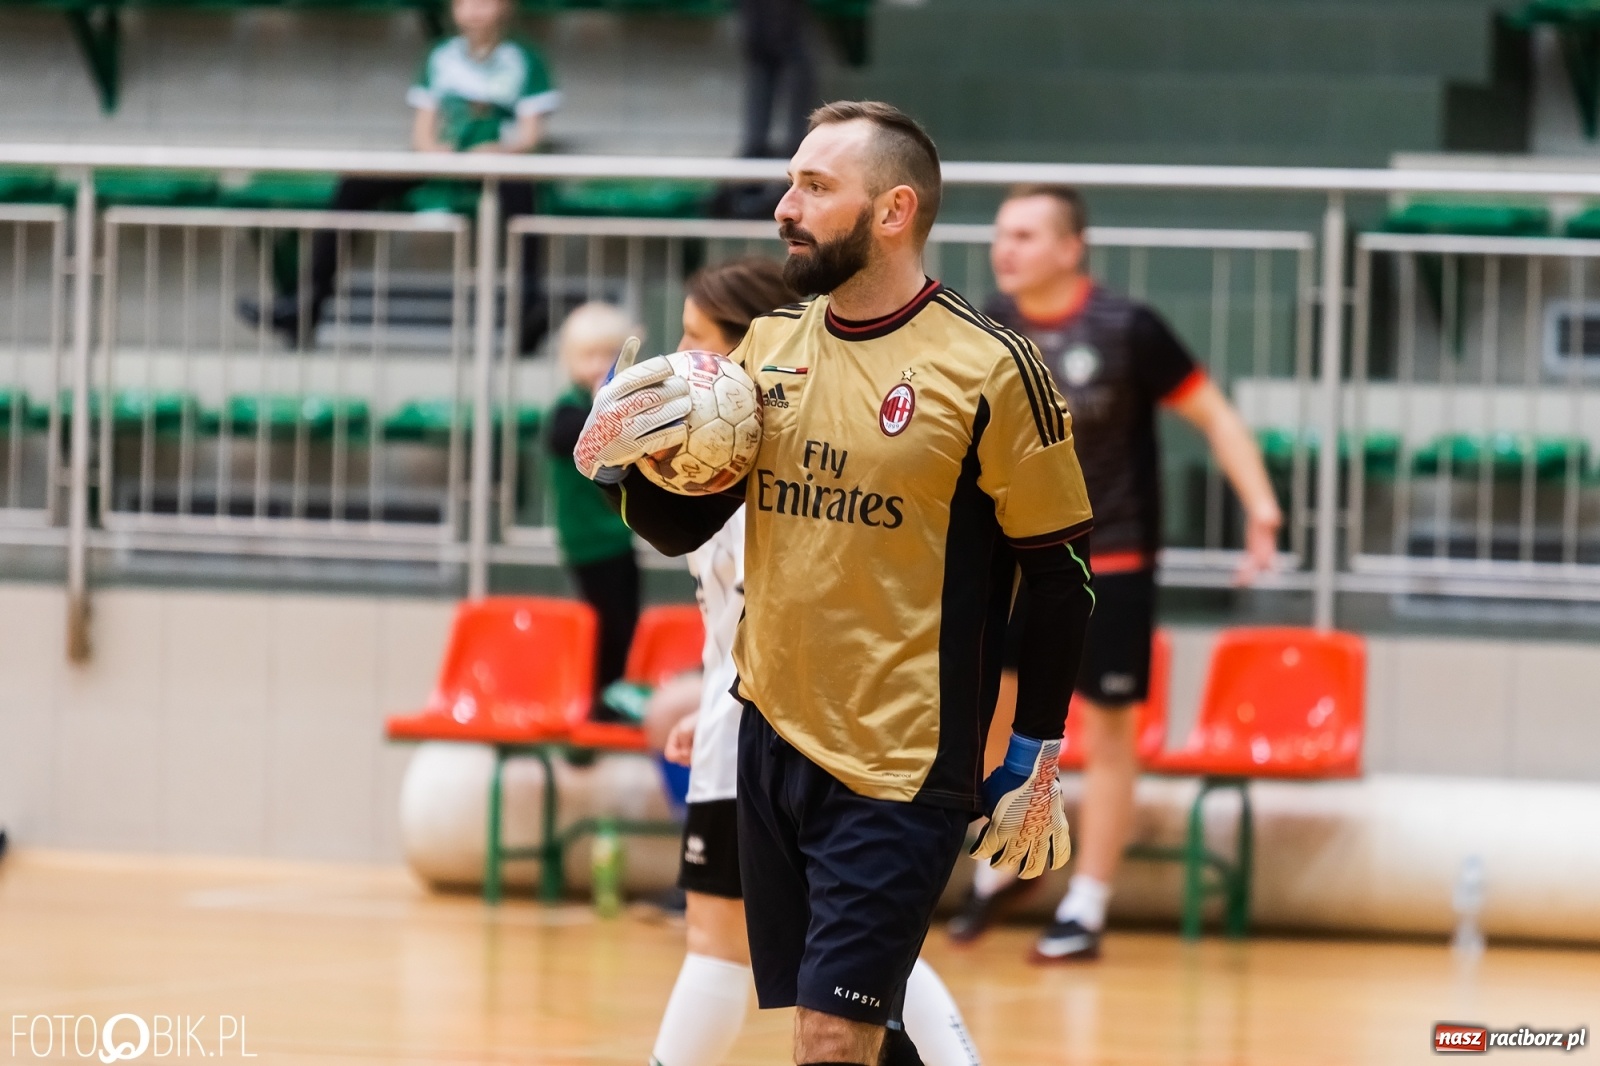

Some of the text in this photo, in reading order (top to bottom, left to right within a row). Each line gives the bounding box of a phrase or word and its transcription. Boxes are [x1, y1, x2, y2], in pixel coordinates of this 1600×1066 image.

[762, 397, 790, 409] didas
[885, 421, 900, 429] 1899
[803, 440, 848, 479] Fly
[757, 469, 904, 529] Emirates
[834, 986, 881, 1008] KIPSTA
